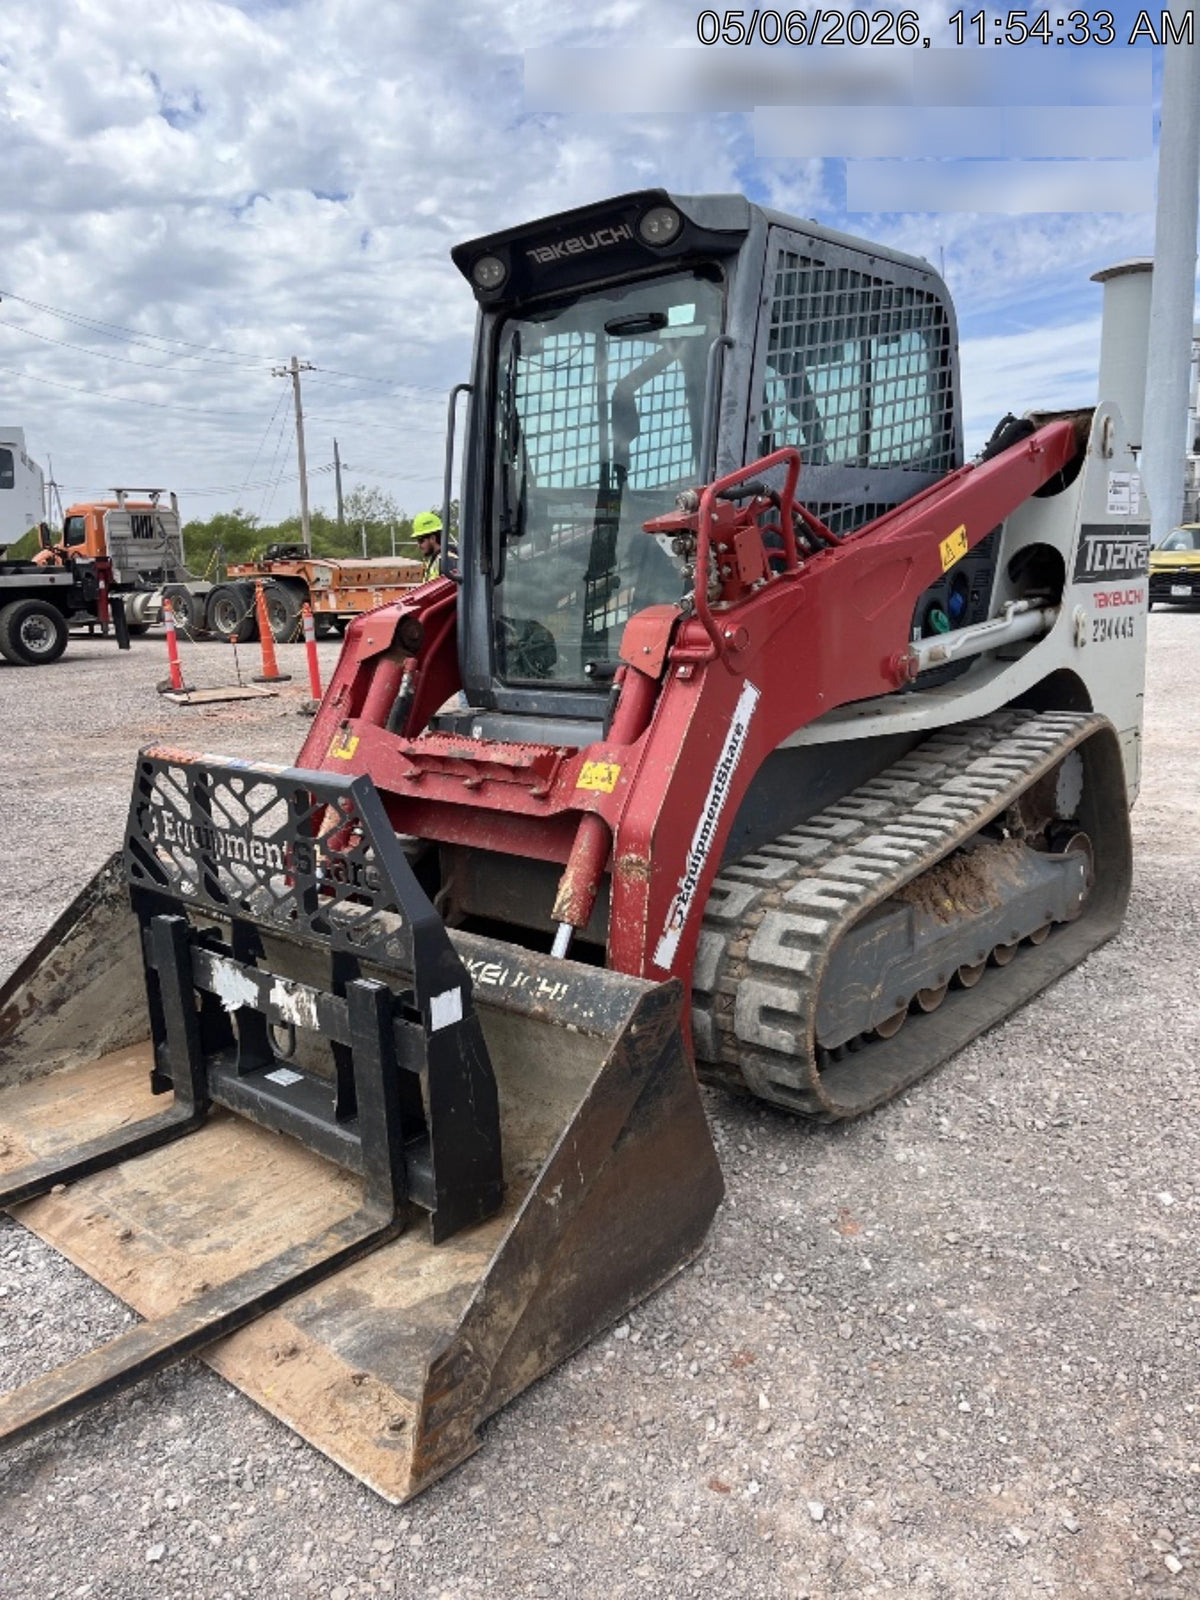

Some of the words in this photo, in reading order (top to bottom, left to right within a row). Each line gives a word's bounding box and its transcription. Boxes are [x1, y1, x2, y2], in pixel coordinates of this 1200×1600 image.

[526, 224, 634, 264] TAKEUCHI
[1093, 589, 1144, 609] TAKEUCHI
[675, 721, 744, 906] EquipmentShare
